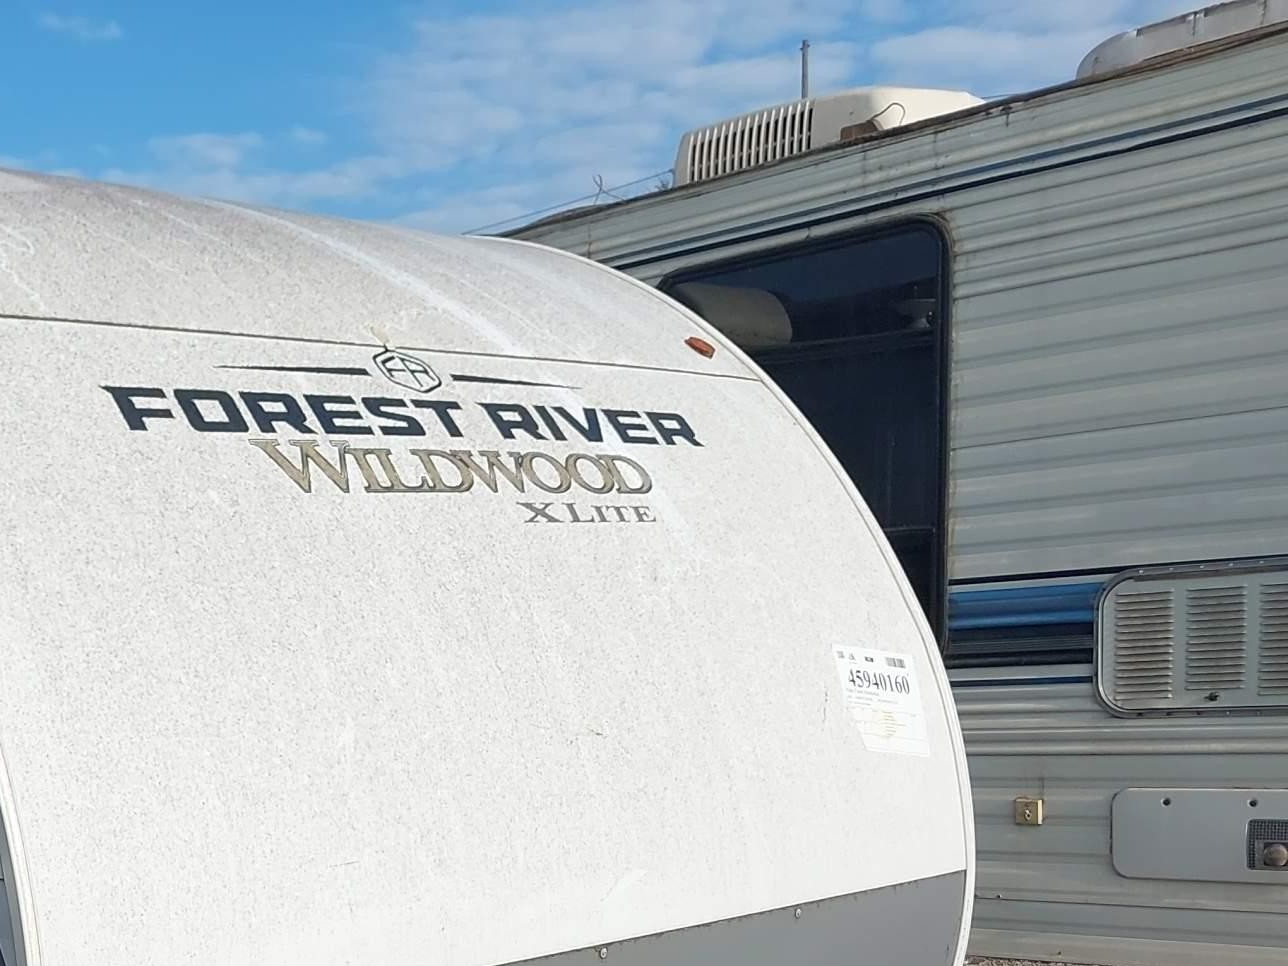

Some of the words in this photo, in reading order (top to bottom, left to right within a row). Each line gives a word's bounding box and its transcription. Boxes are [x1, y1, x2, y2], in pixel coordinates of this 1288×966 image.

[101, 386, 468, 437] FOREST
[476, 401, 705, 448] RIVER
[251, 440, 653, 494] WILDWOOD
[848, 668, 910, 695] 45940160
